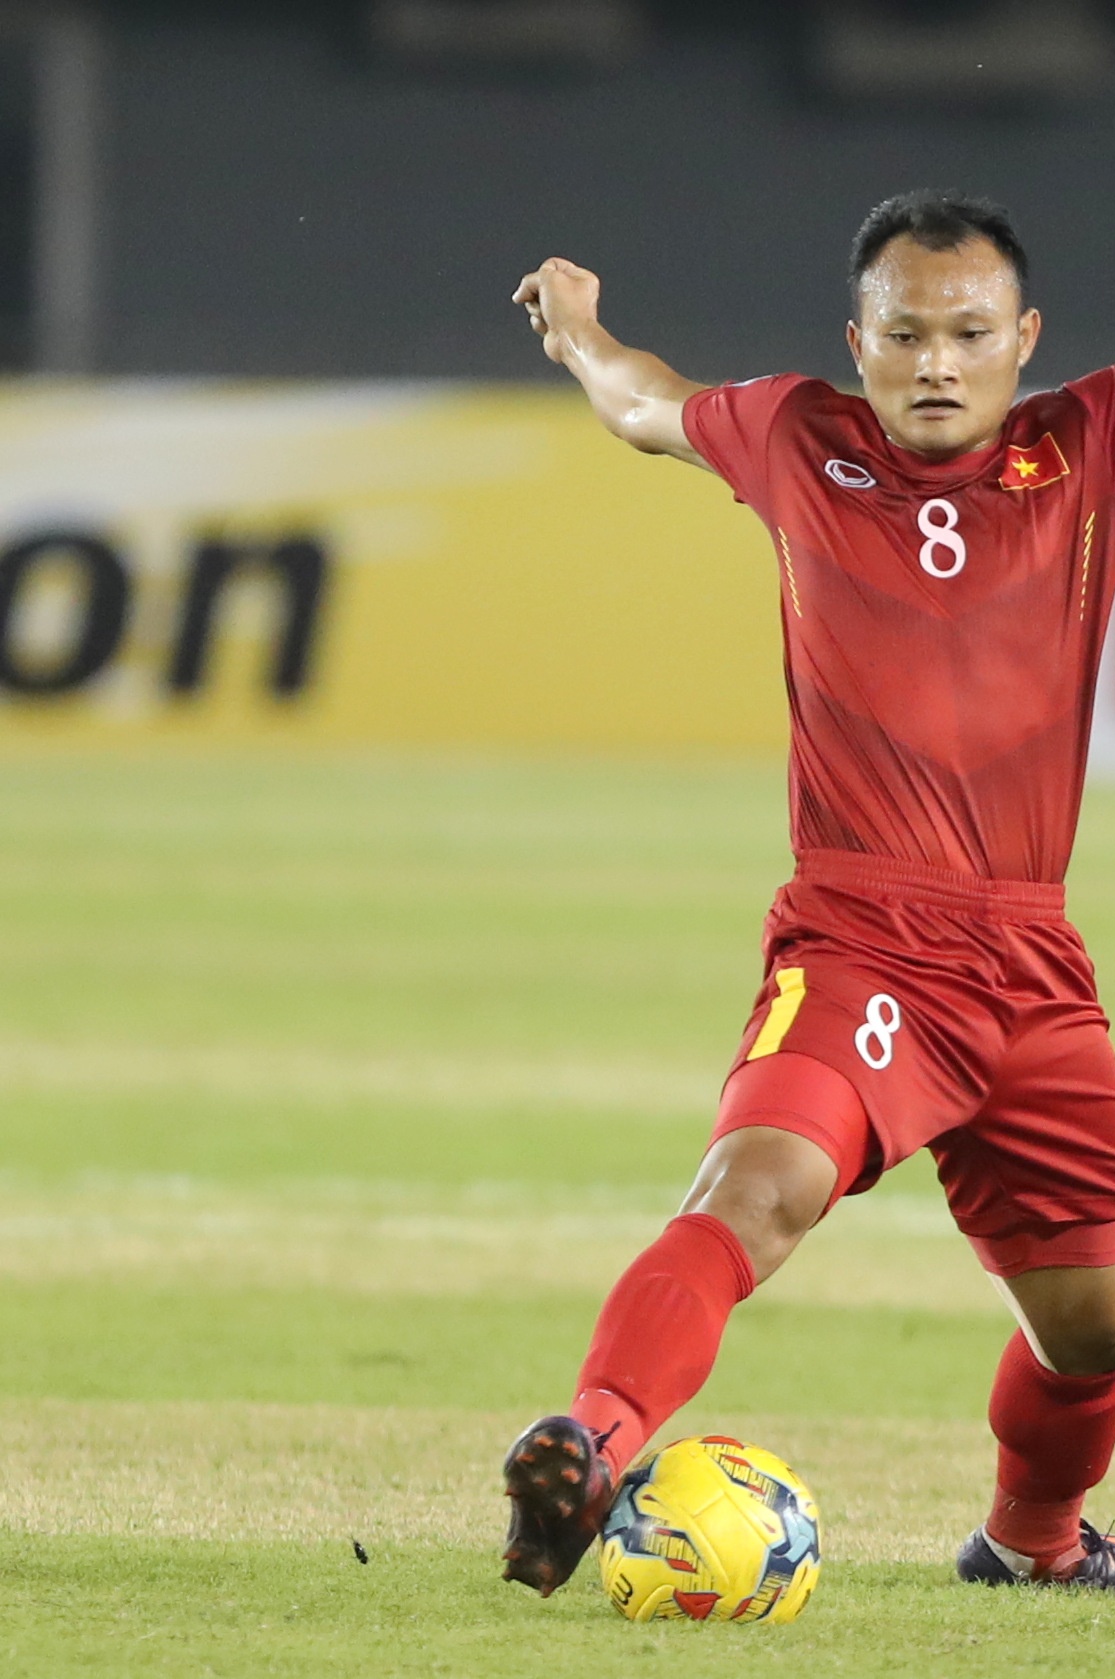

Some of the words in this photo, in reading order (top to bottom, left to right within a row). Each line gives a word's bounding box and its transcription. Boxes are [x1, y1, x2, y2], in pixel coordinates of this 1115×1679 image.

[917, 498, 967, 579] 8
[0, 527, 330, 700] on
[853, 993, 901, 1070] 8
